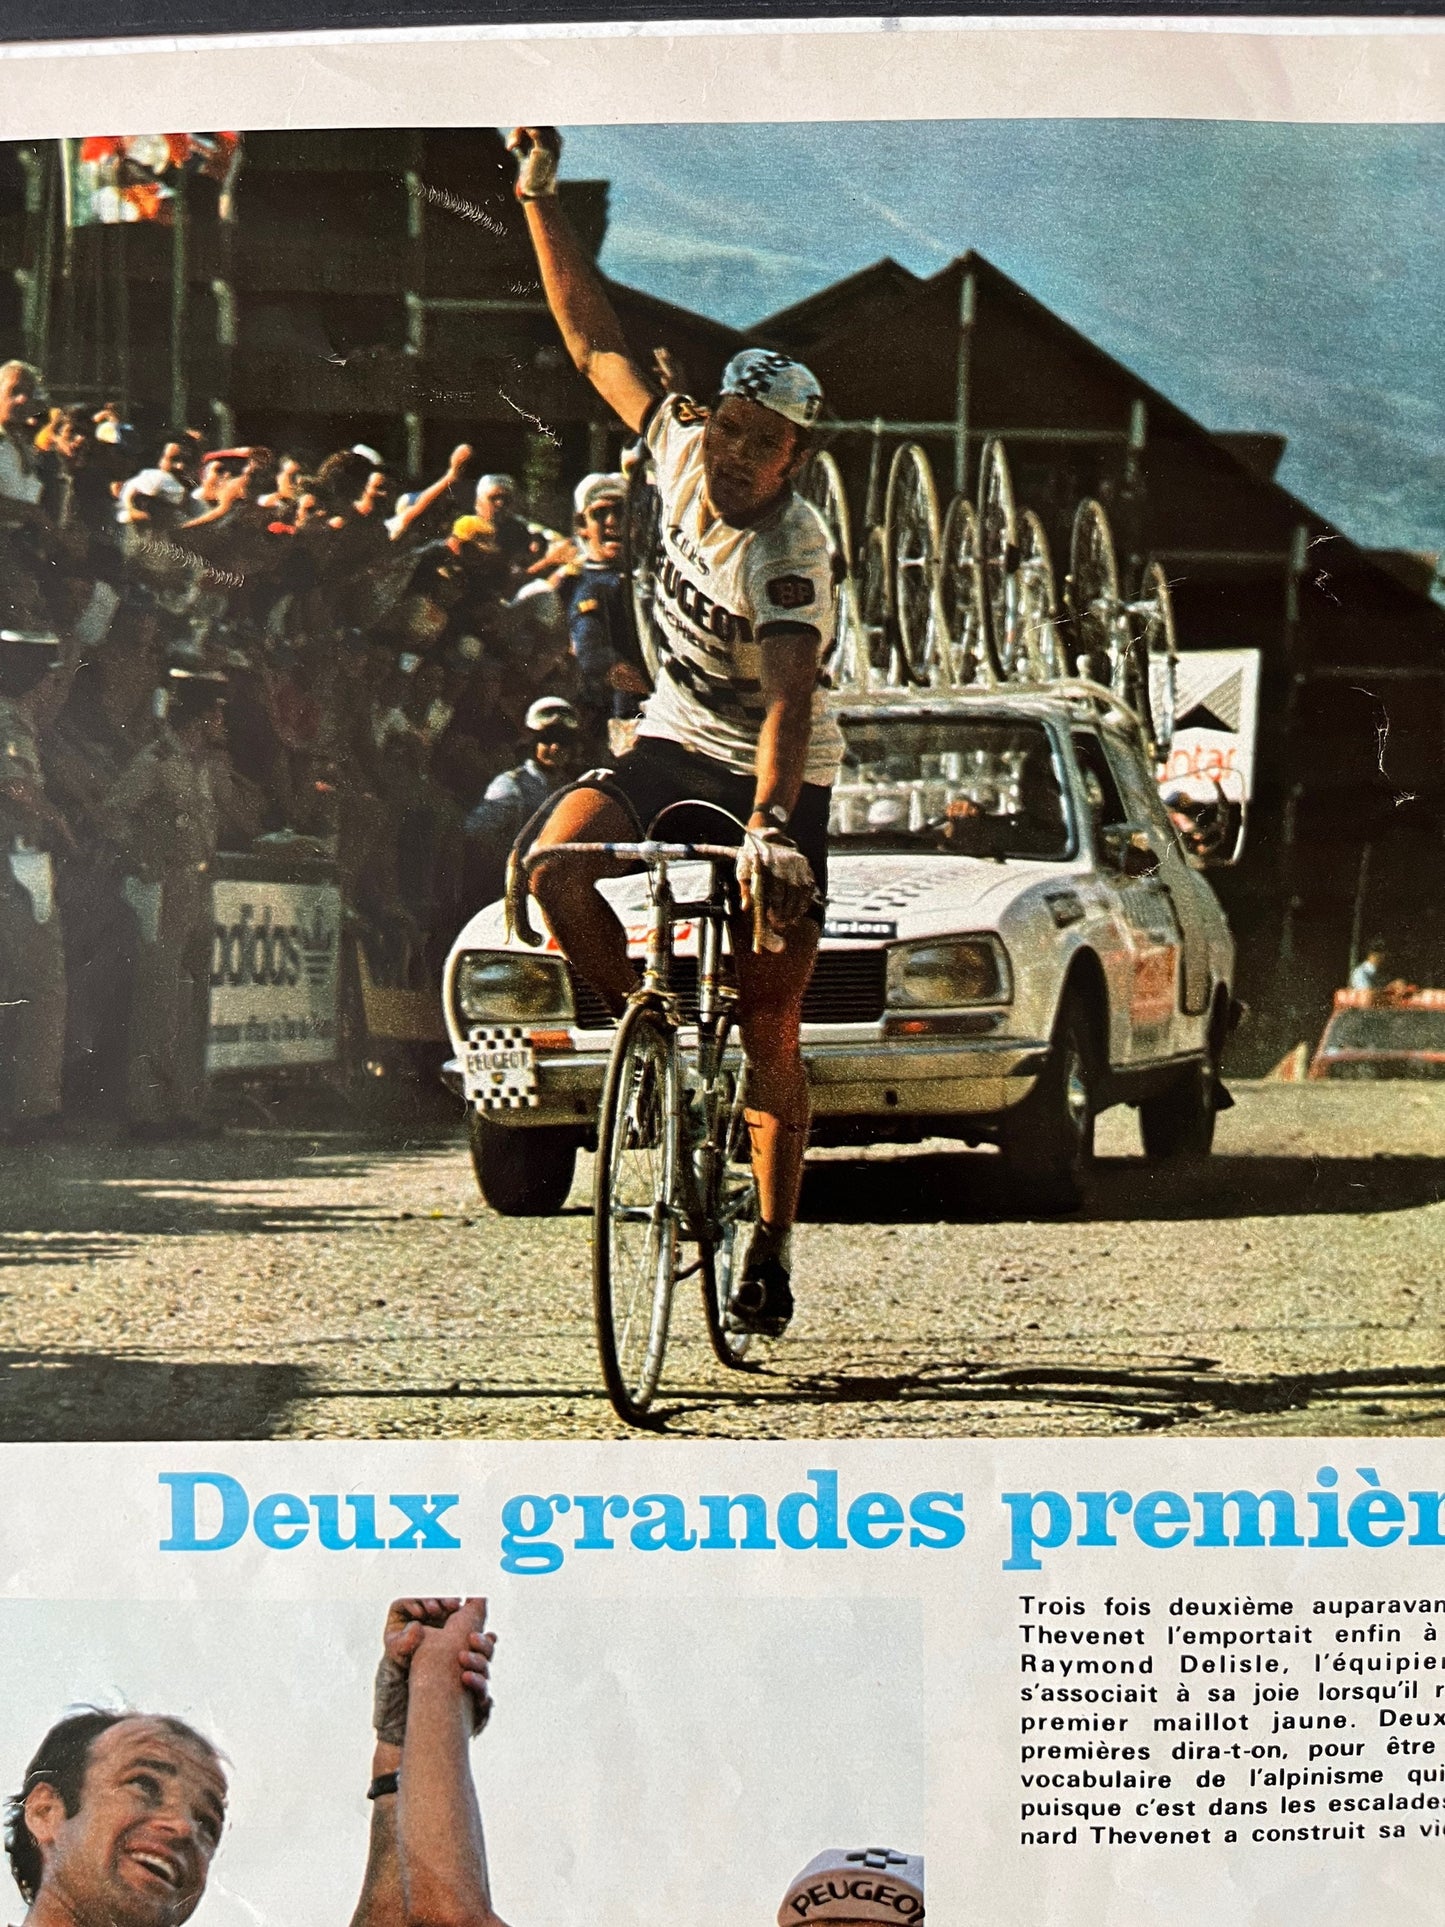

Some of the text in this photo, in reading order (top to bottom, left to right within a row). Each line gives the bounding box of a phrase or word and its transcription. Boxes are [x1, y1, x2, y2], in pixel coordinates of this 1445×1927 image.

[160, 1465, 1445, 1575] Deux grandes premièr
[1019, 1595, 1445, 1619] Trois fois deuxième auparavan
[1018, 1622, 1437, 1649] Thevenet l'emportait enfin à
[1021, 1654, 1153, 1678] Raymond
[1180, 1654, 1289, 1676] Delisle,
[1020, 1680, 1445, 1706] s'associait à sa joie lorsqu'il r
[1021, 1709, 1445, 1735] premier maillot jaune. Deux
[1021, 1735, 1436, 1764] premières dira-t-on, pour être
[1020, 1763, 1445, 1790] vocabulaire de l'alpinisme qui
[1021, 1792, 1445, 1821] puisque c'est dans les escalade
[1021, 1819, 1445, 1845] nard Thevenet a construit sa vi
